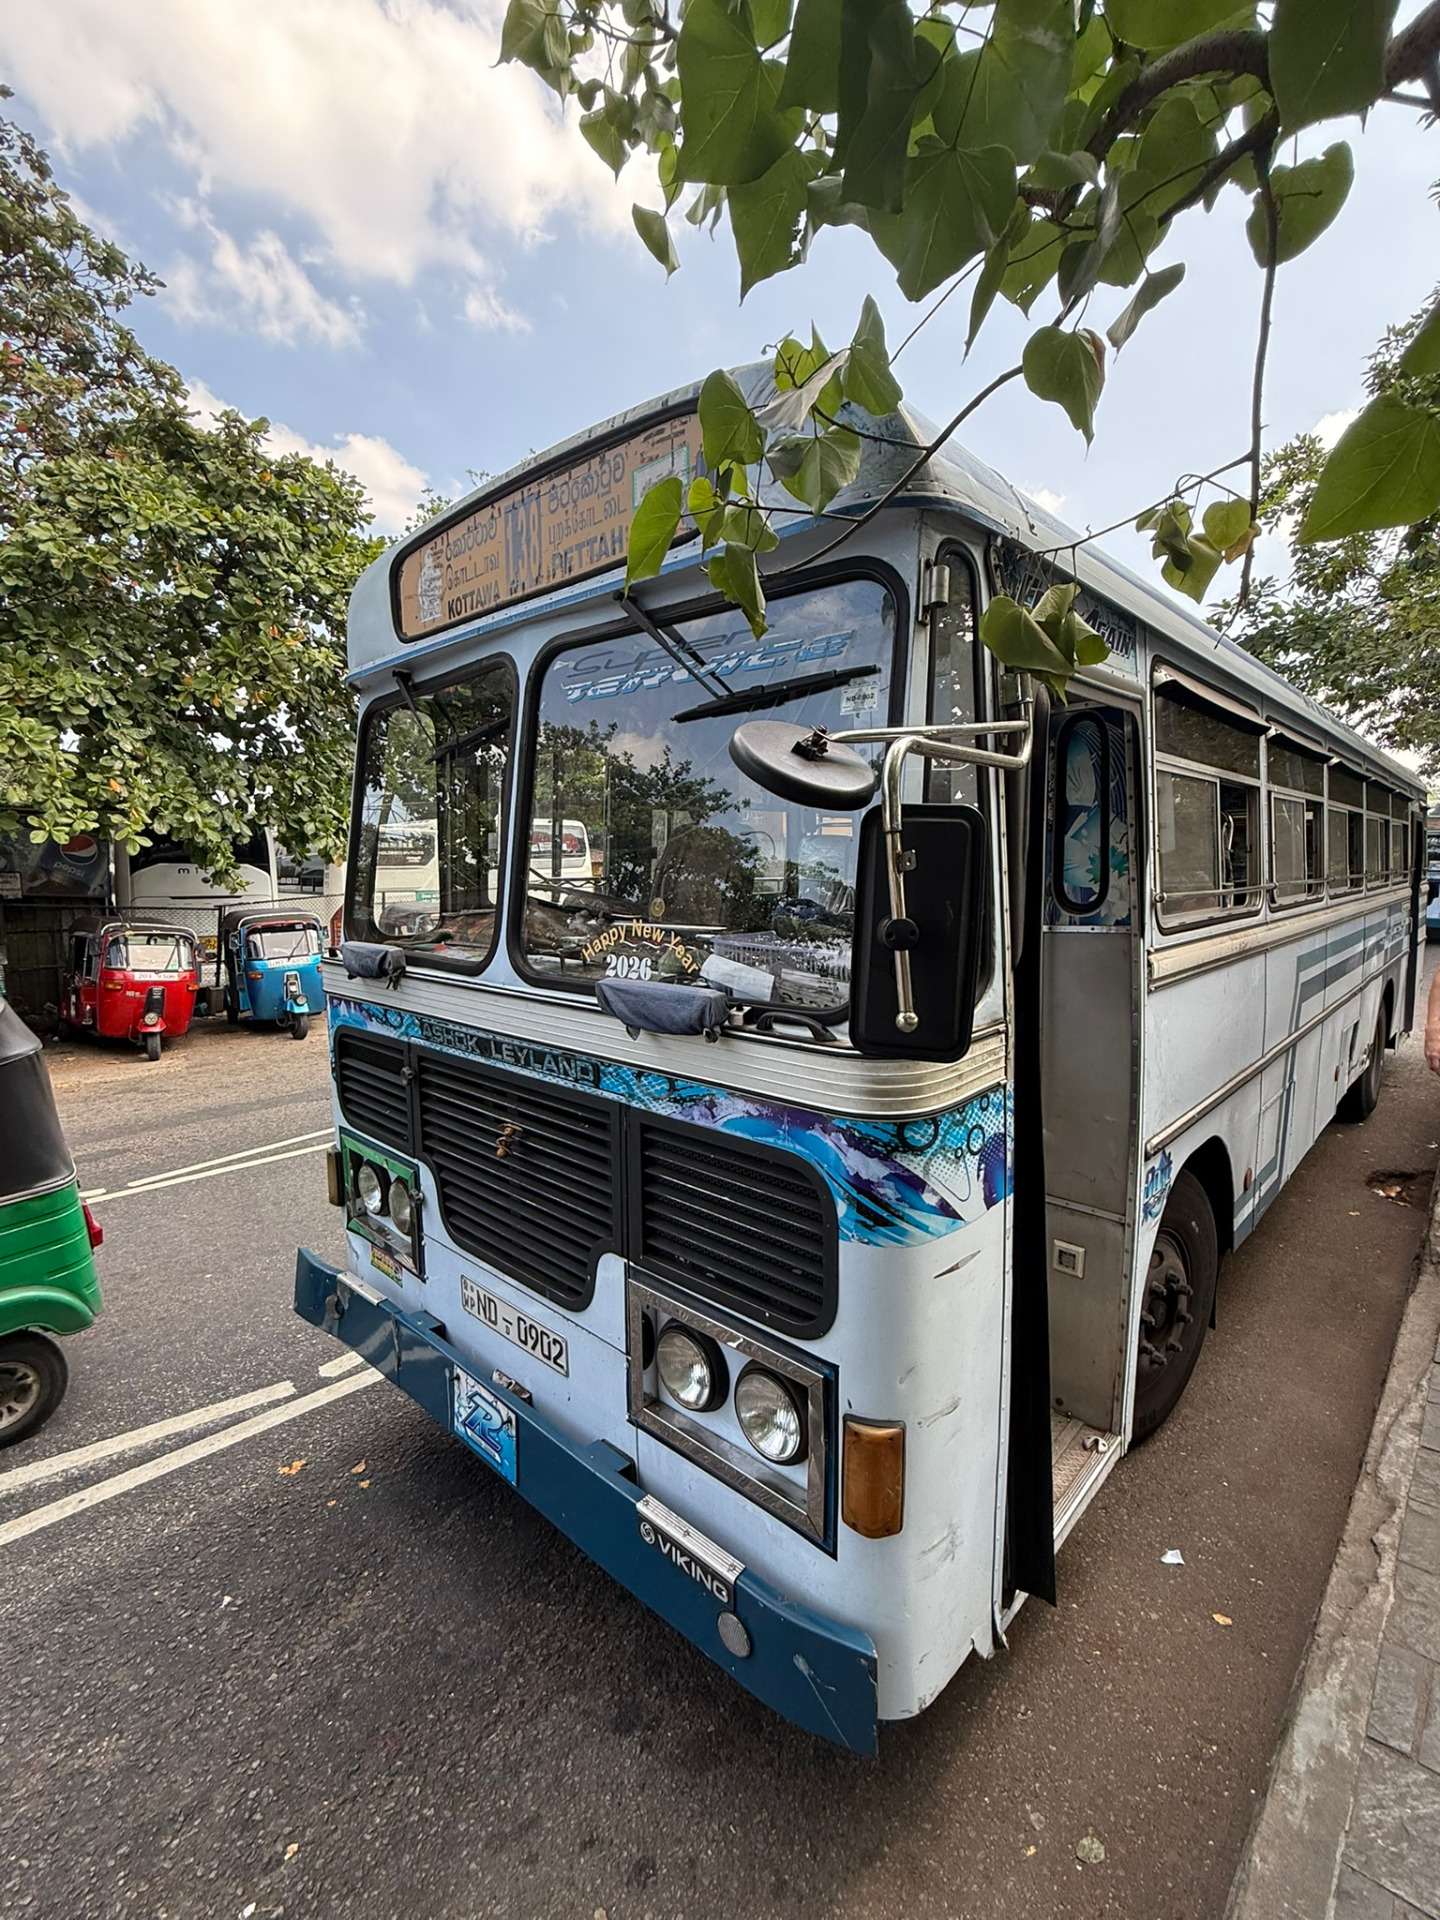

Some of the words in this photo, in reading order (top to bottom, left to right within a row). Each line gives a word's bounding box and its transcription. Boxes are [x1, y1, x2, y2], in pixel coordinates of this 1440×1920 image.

[448, 580, 500, 620] KOTTAWA
[53, 861, 86, 878] pepsi
[582, 924, 627, 962] Happy
[631, 918, 665, 943] New
[670, 930, 700, 974] Year
[605, 954, 652, 980] 2026
[422, 1022, 481, 1054] ASHOK
[490, 1038, 595, 1082] LEYLAND
[463, 1292, 476, 1311] WP
[658, 1533, 729, 1603] VIKING
